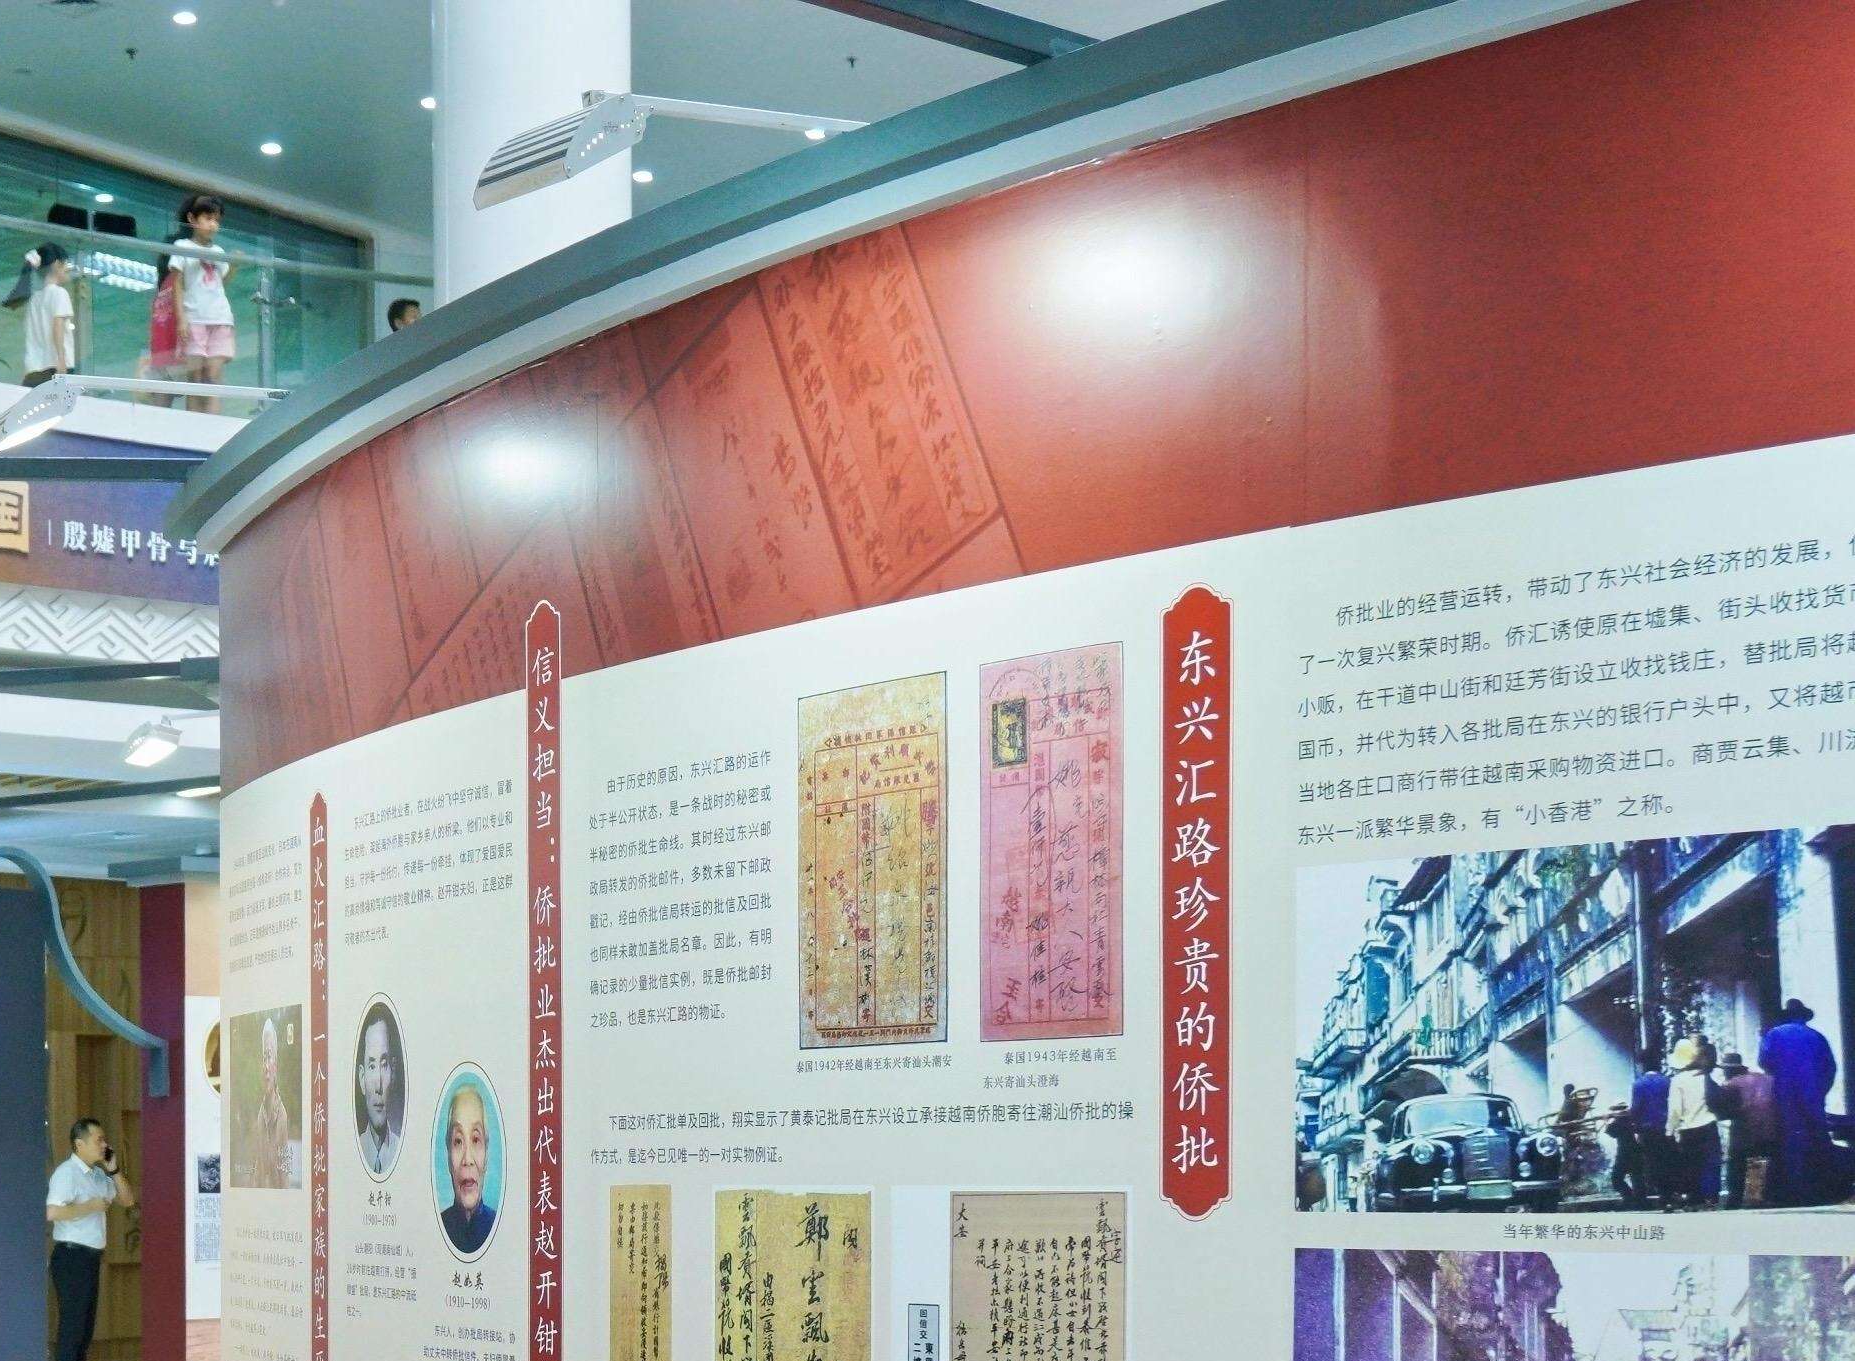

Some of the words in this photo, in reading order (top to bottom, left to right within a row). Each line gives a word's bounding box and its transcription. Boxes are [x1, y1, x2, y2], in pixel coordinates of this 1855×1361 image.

[1171, 630, 1222, 1175] 东兴汇路珍贵的侨批
[1502, 1223, 1666, 1242] 当年繁华的东兴中山路
